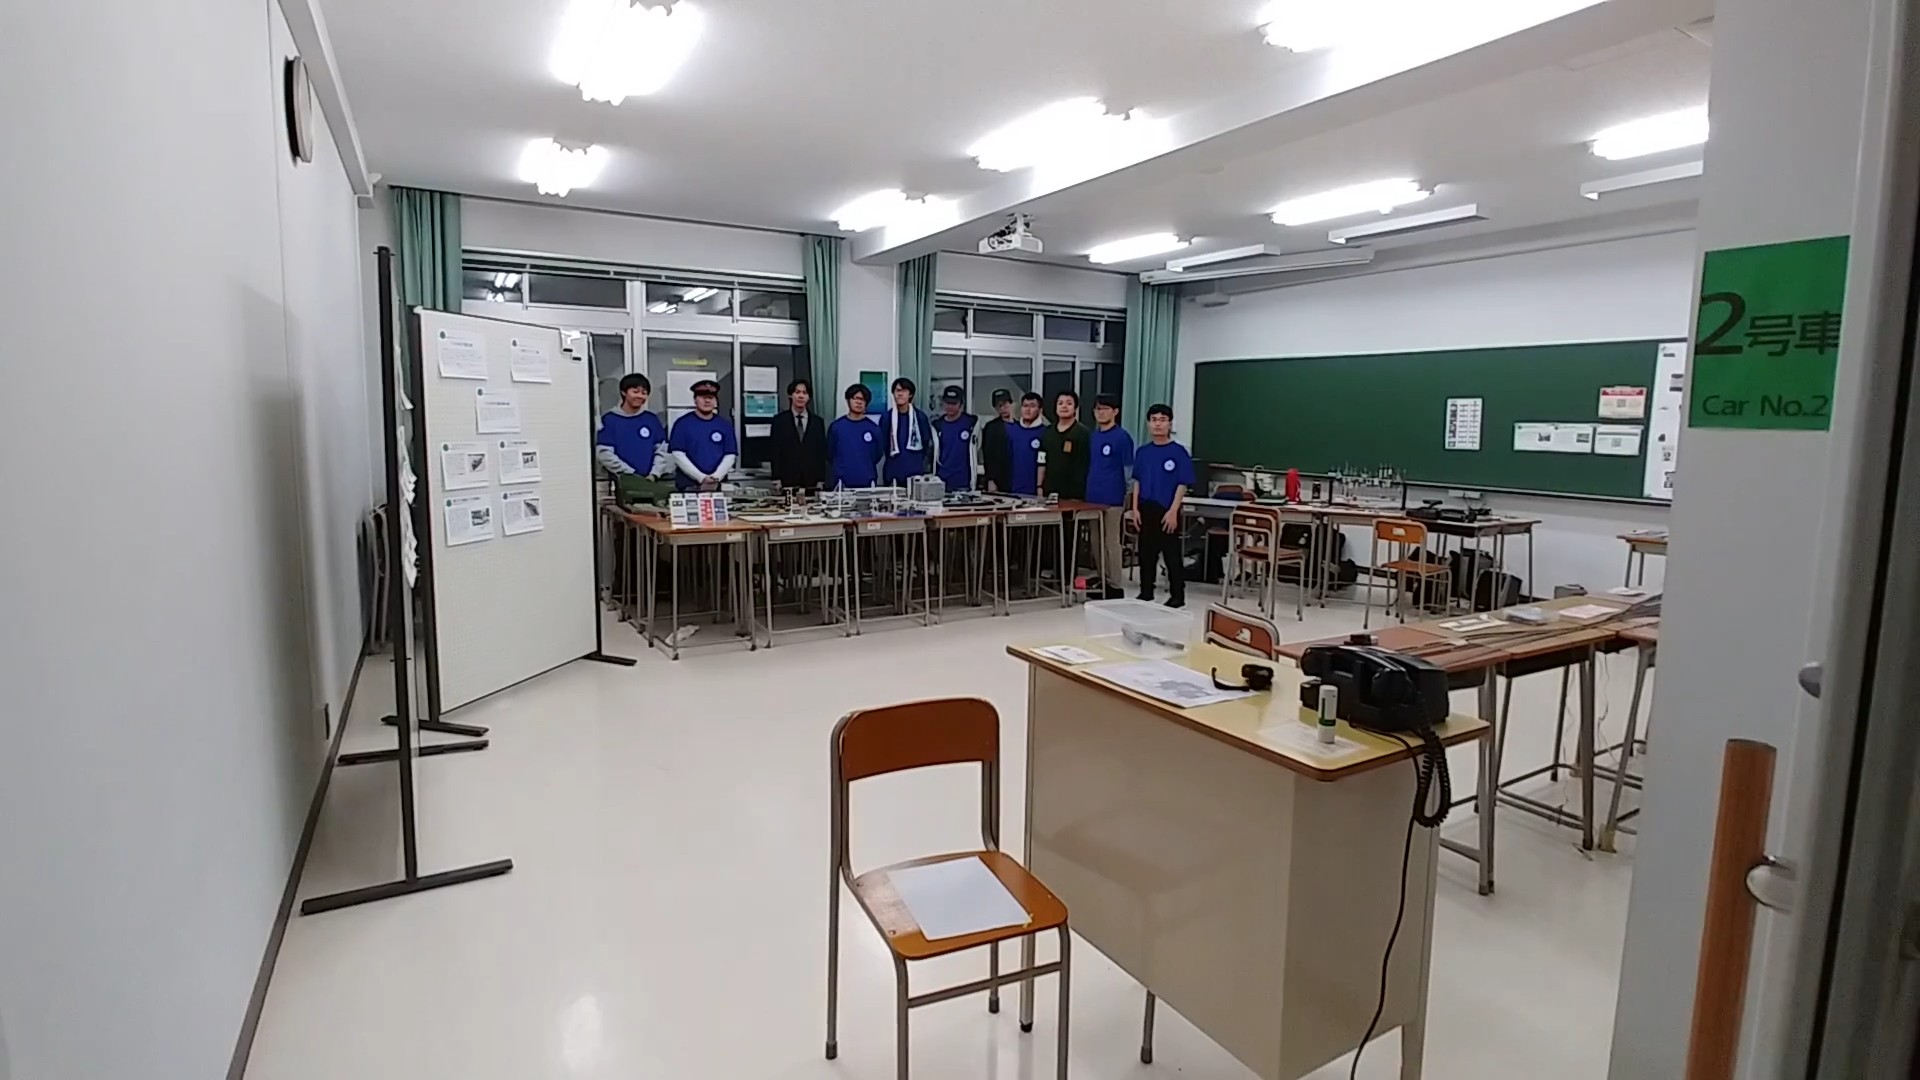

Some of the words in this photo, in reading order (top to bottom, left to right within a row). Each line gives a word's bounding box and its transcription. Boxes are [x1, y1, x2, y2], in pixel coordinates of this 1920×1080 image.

[1695, 291, 1842, 357] 2号車
[1702, 394, 1749, 416] Car
[1760, 394, 1830, 417] No.2
